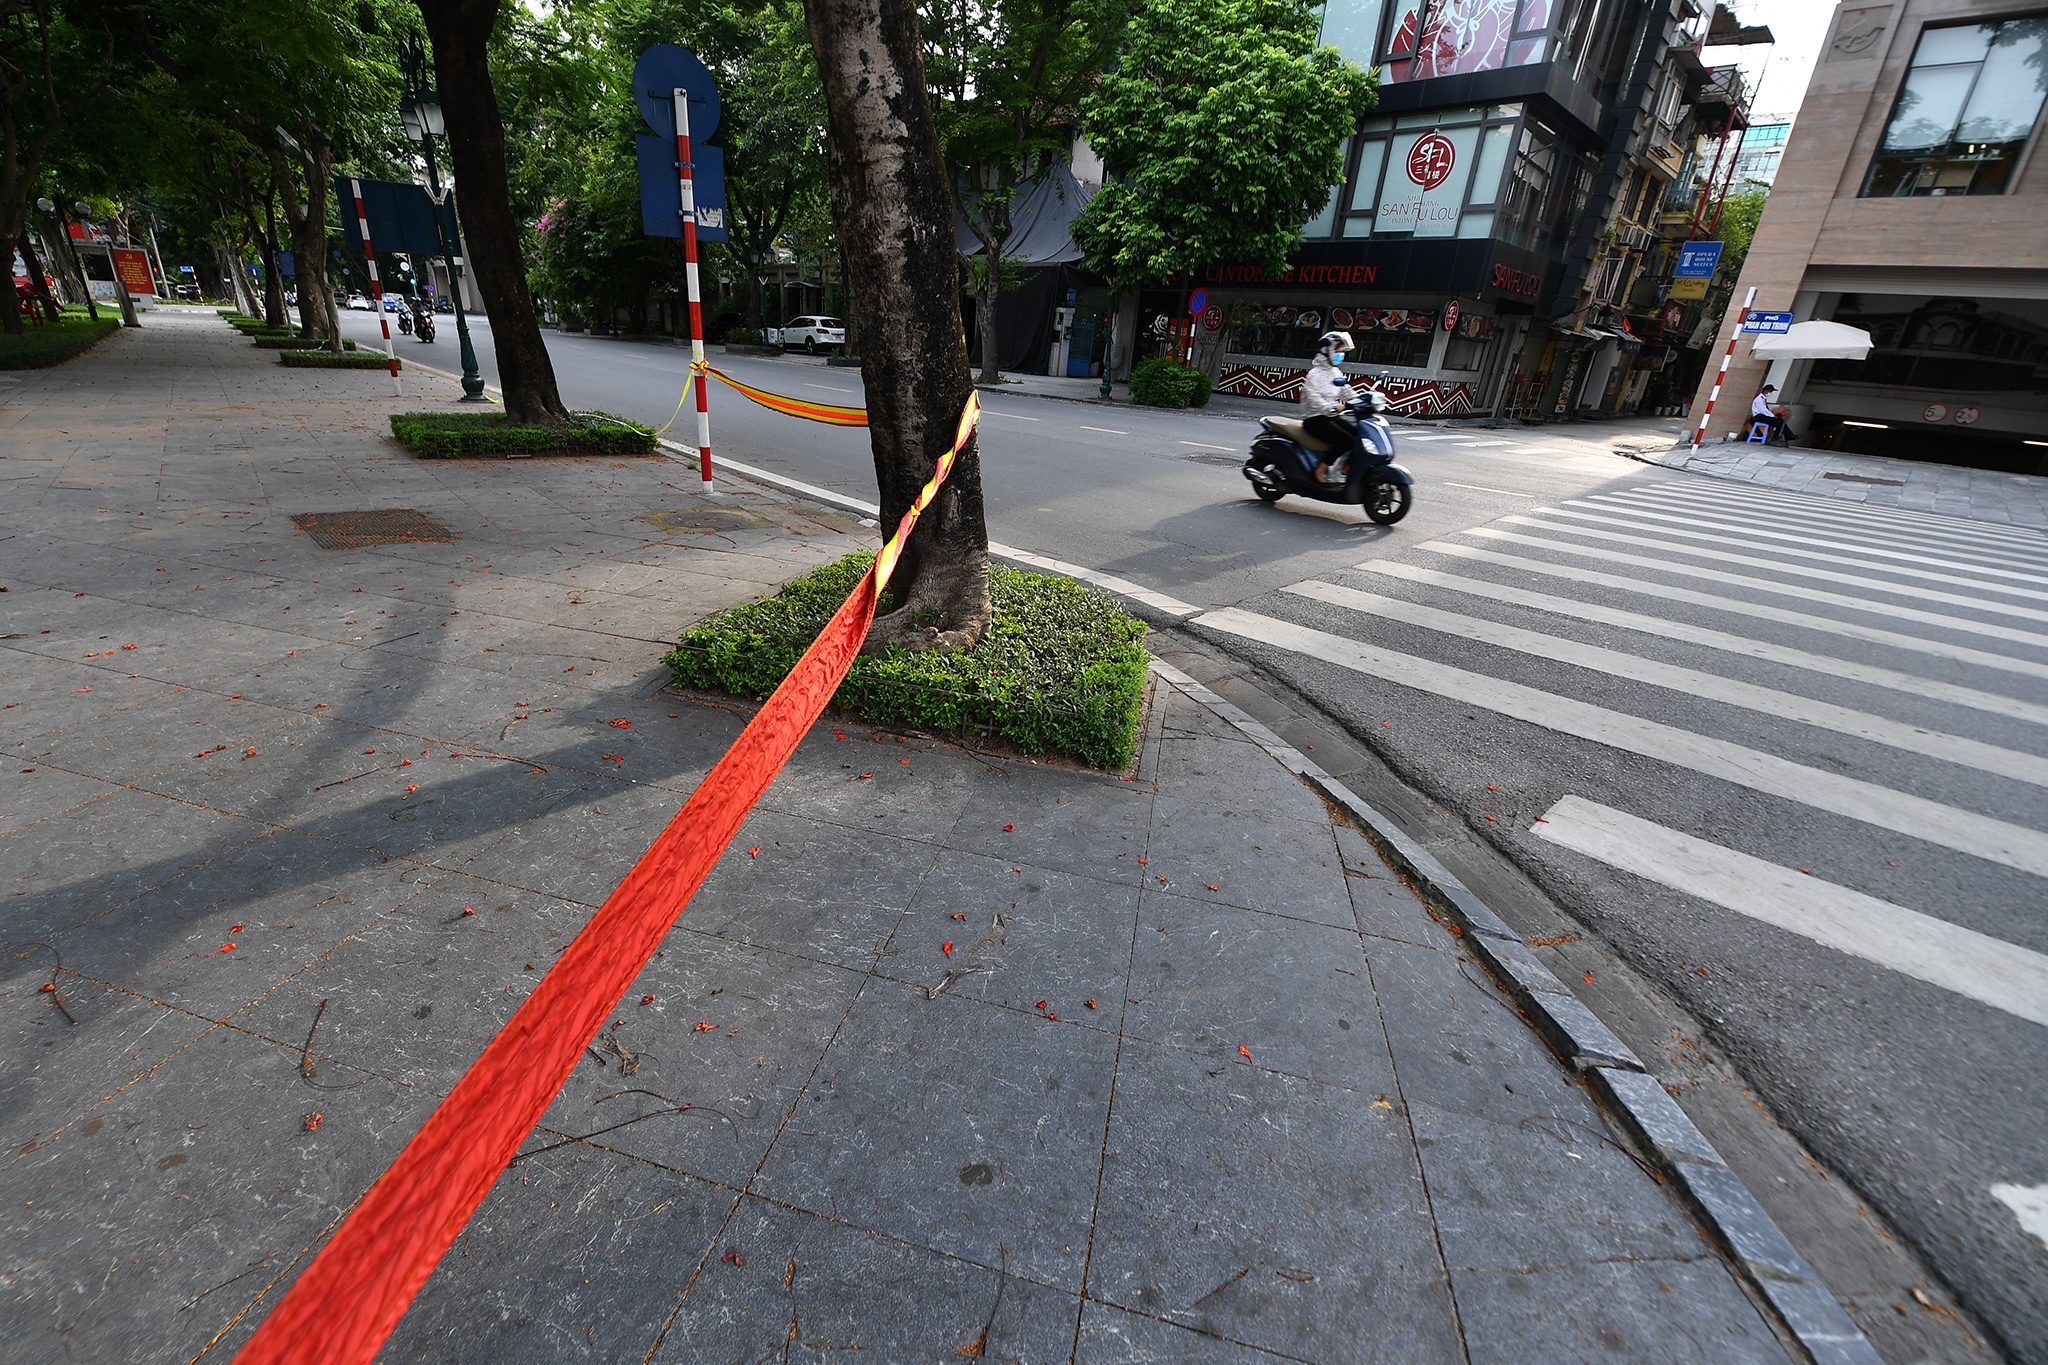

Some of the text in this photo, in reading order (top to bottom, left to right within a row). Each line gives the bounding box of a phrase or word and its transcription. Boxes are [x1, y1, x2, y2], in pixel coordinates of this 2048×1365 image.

[1381, 202, 1459, 221] SAN FU LOU
[1298, 265, 1377, 283] KITCHEN
